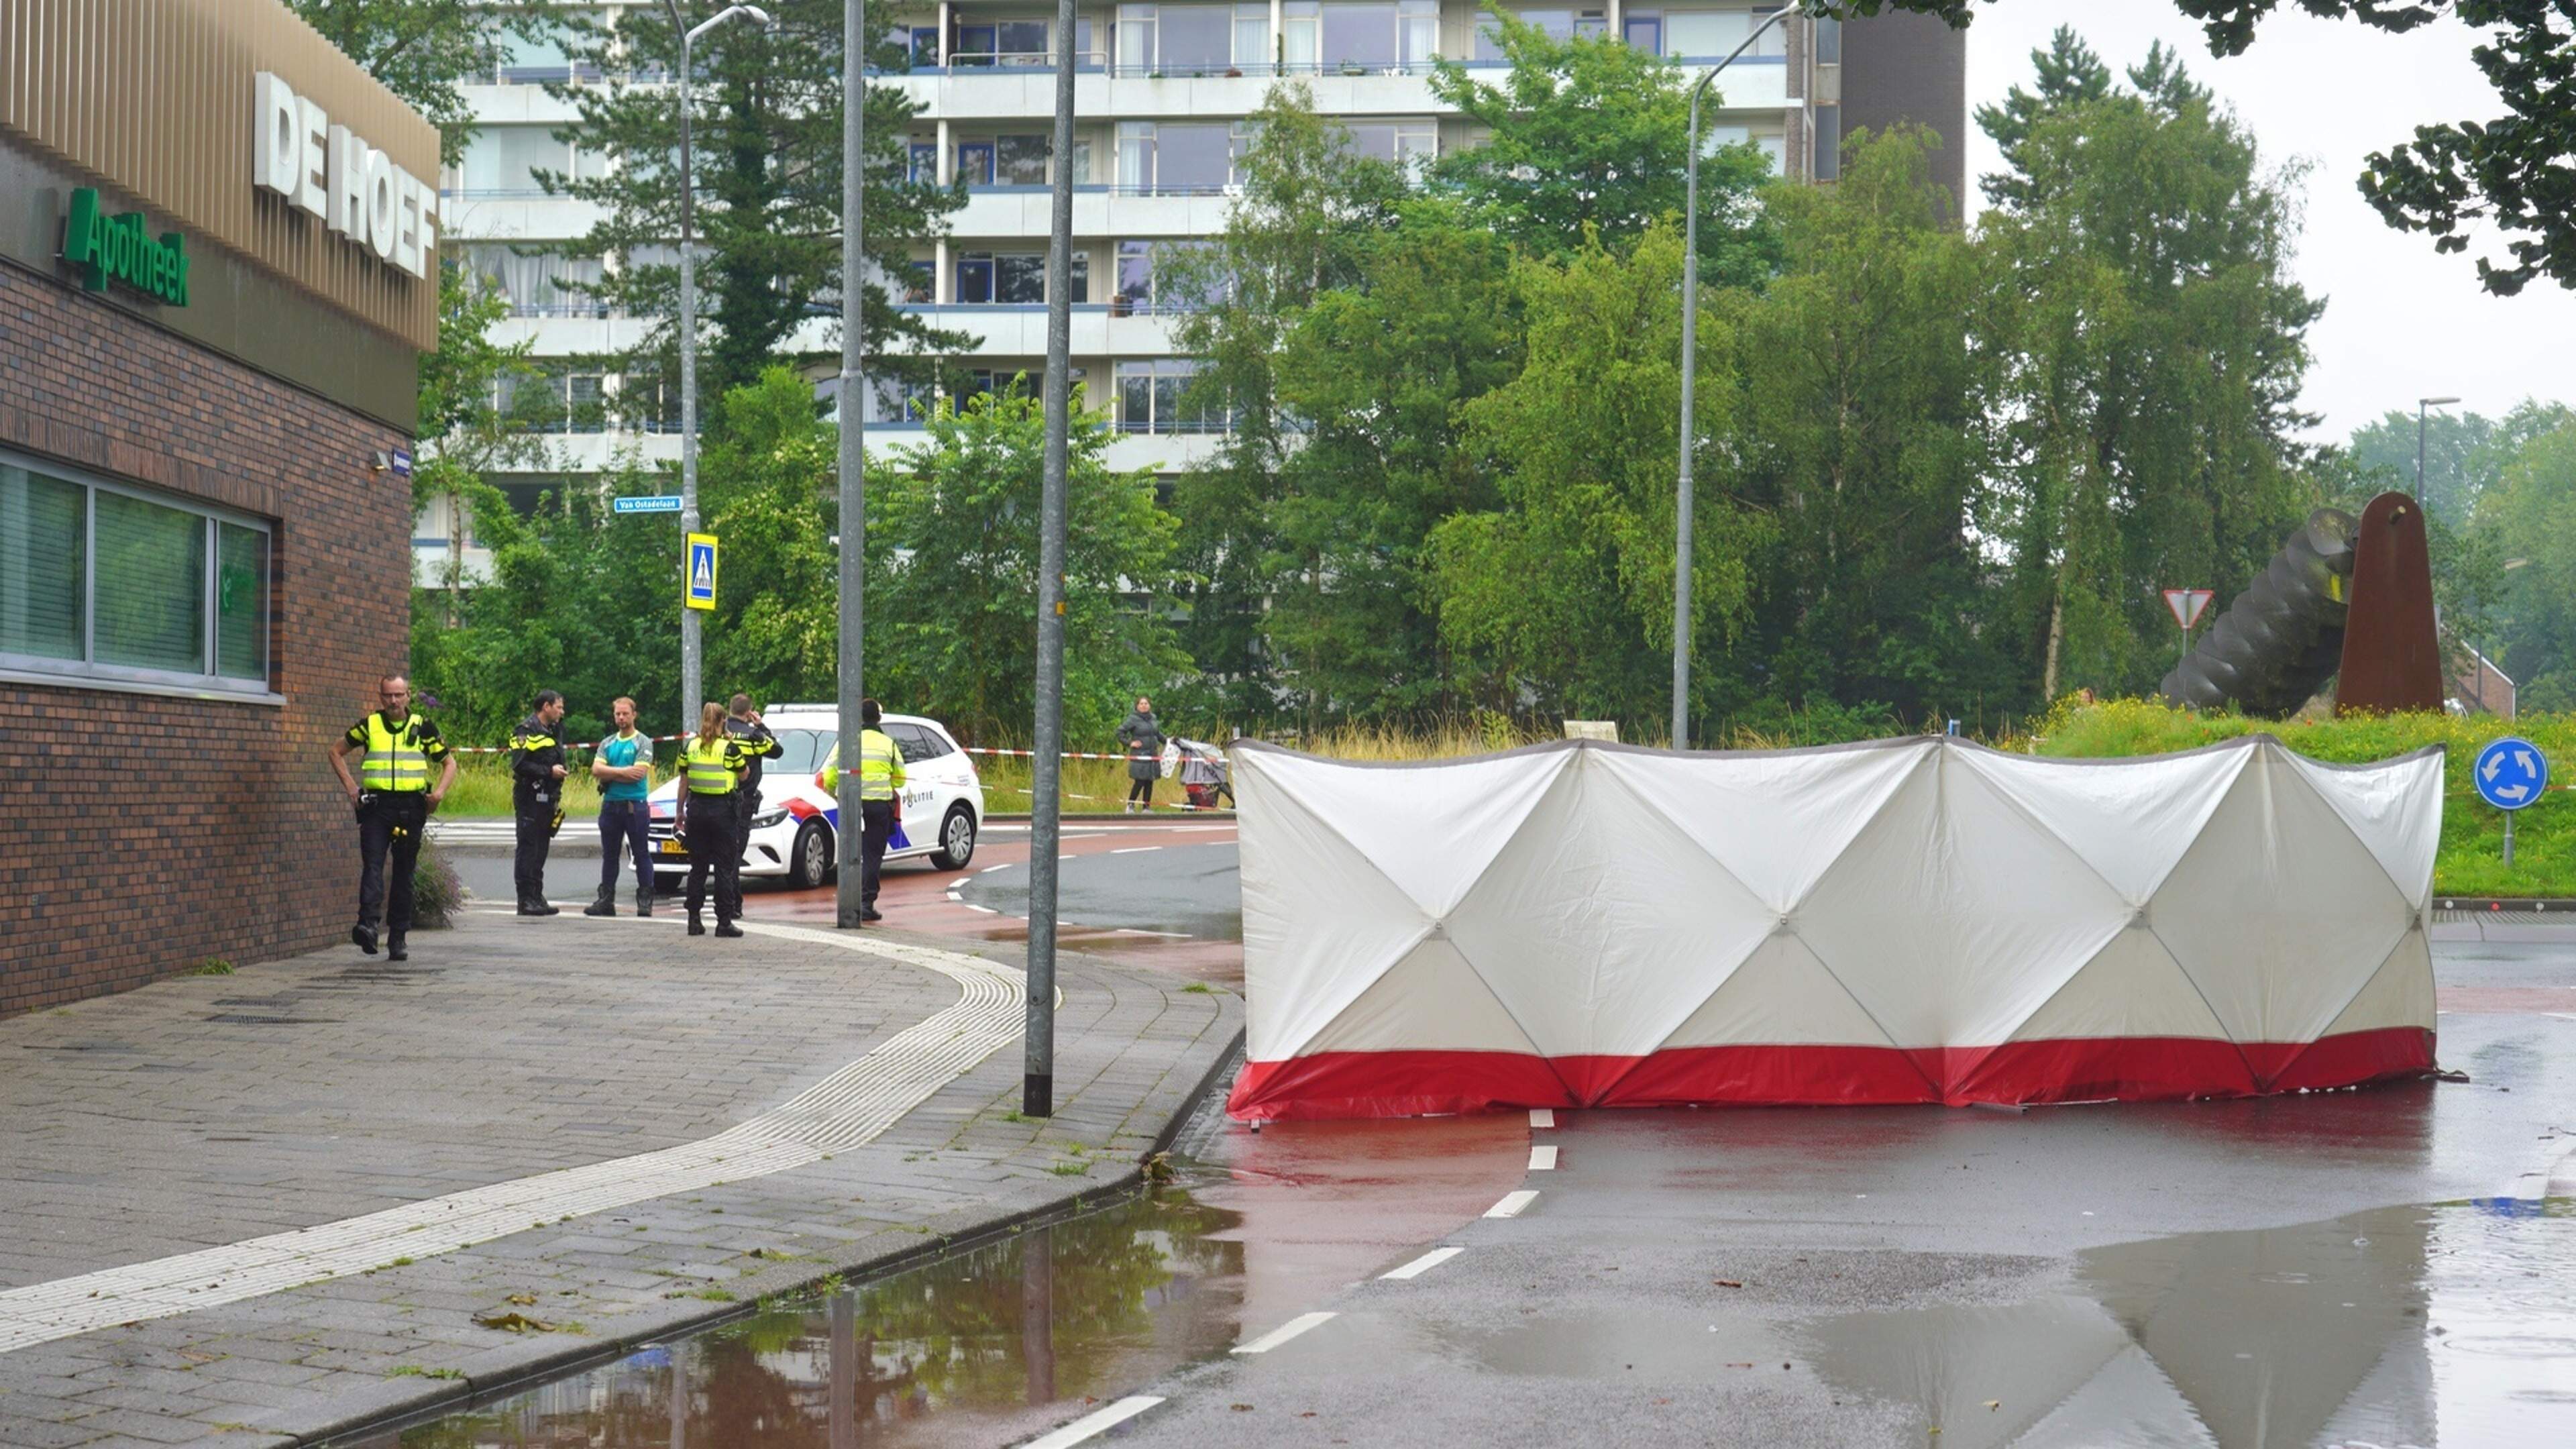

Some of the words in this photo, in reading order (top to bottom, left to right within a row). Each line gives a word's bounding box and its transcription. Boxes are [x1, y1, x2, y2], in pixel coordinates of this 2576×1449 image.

[254, 71, 327, 220] DE
[328, 125, 437, 280] HOEF
[66, 189, 191, 307] Apotheek
[619, 500, 634, 509] Van
